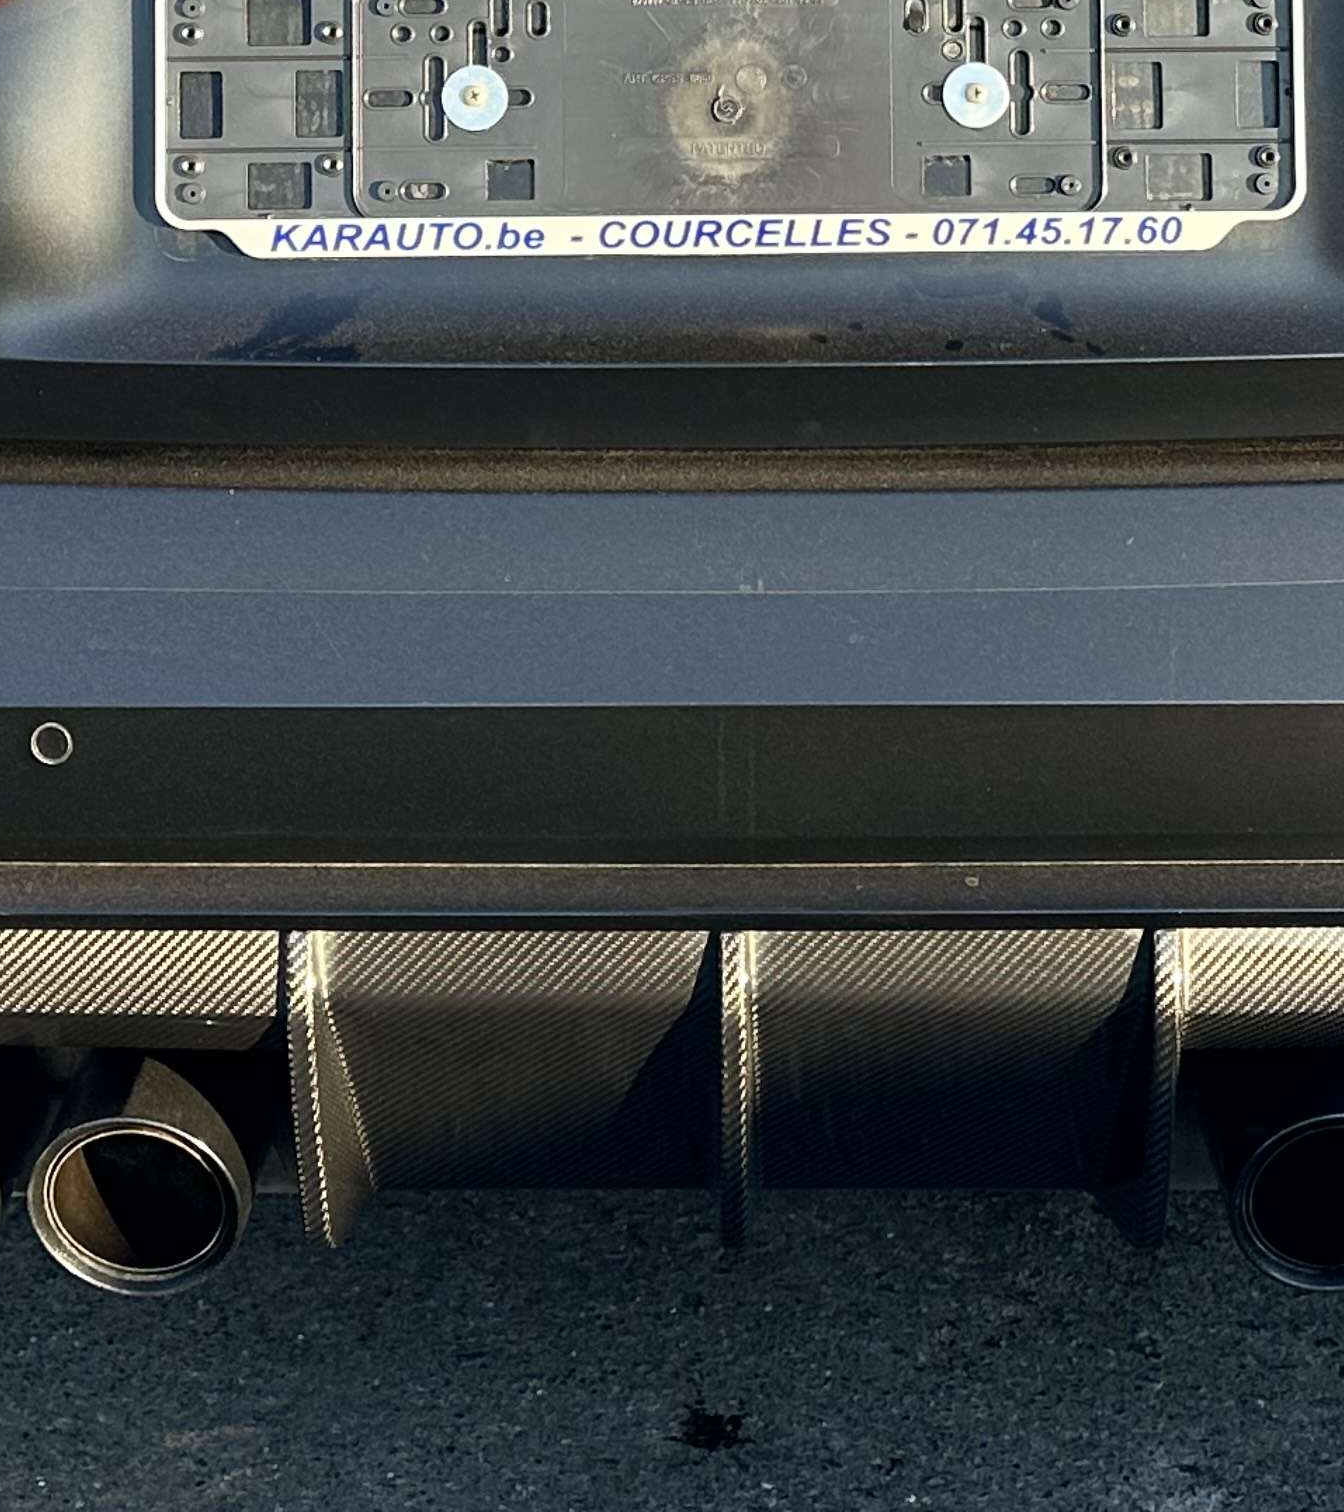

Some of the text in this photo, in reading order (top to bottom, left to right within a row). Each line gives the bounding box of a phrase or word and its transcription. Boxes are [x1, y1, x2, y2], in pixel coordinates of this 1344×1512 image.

[270, 222, 545, 252] KARAUTO.be
[599, 218, 891, 249] COURCELLES
[932, 216, 1183, 246] 071.45.17.60
